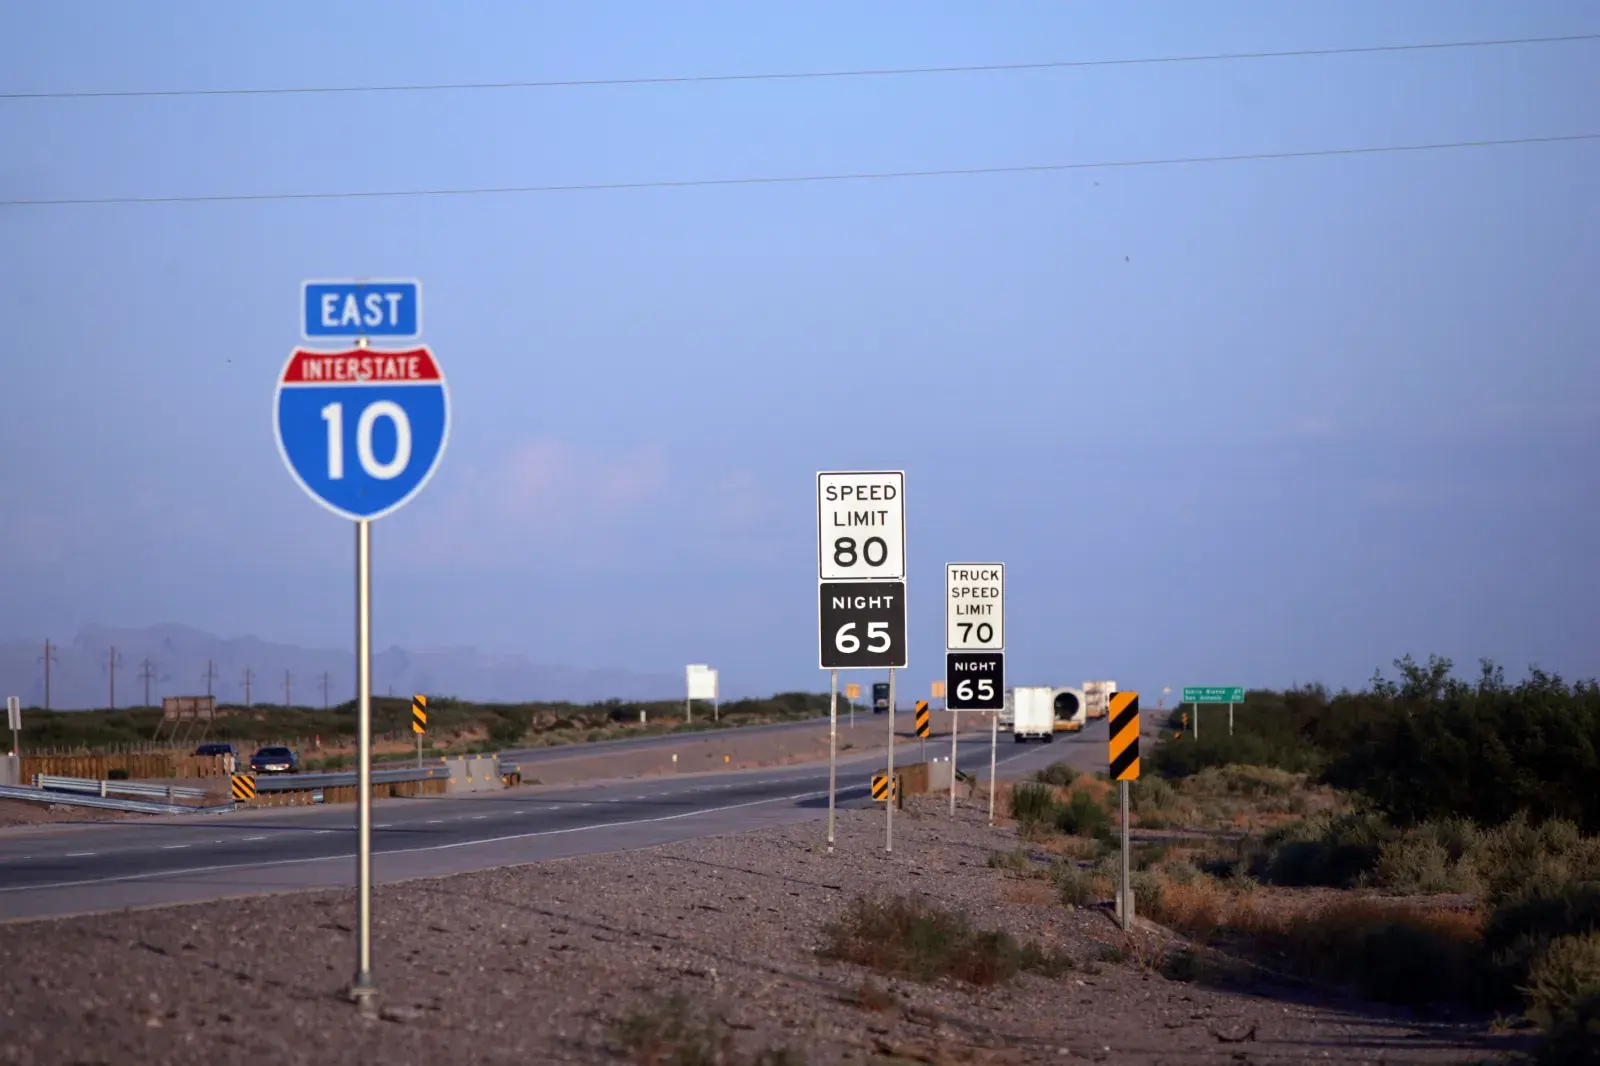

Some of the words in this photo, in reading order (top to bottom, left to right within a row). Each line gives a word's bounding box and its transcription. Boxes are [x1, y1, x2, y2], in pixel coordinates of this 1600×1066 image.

[321, 293, 403, 328] EAST
[302, 357, 421, 380] INTERSTATE
[321, 400, 413, 481] 10
[826, 485, 897, 502] SPEED
[834, 511, 888, 527] LIMIT
[833, 536, 888, 568] 80
[951, 570, 999, 581] TRUCK
[951, 587, 999, 598] SPEED
[832, 596, 894, 610] NIGHT
[956, 604, 993, 616] LIMIT
[835, 621, 892, 654] 65
[957, 622, 993, 644] 70
[955, 661, 996, 672] NIGHT
[956, 679, 995, 701] 65
